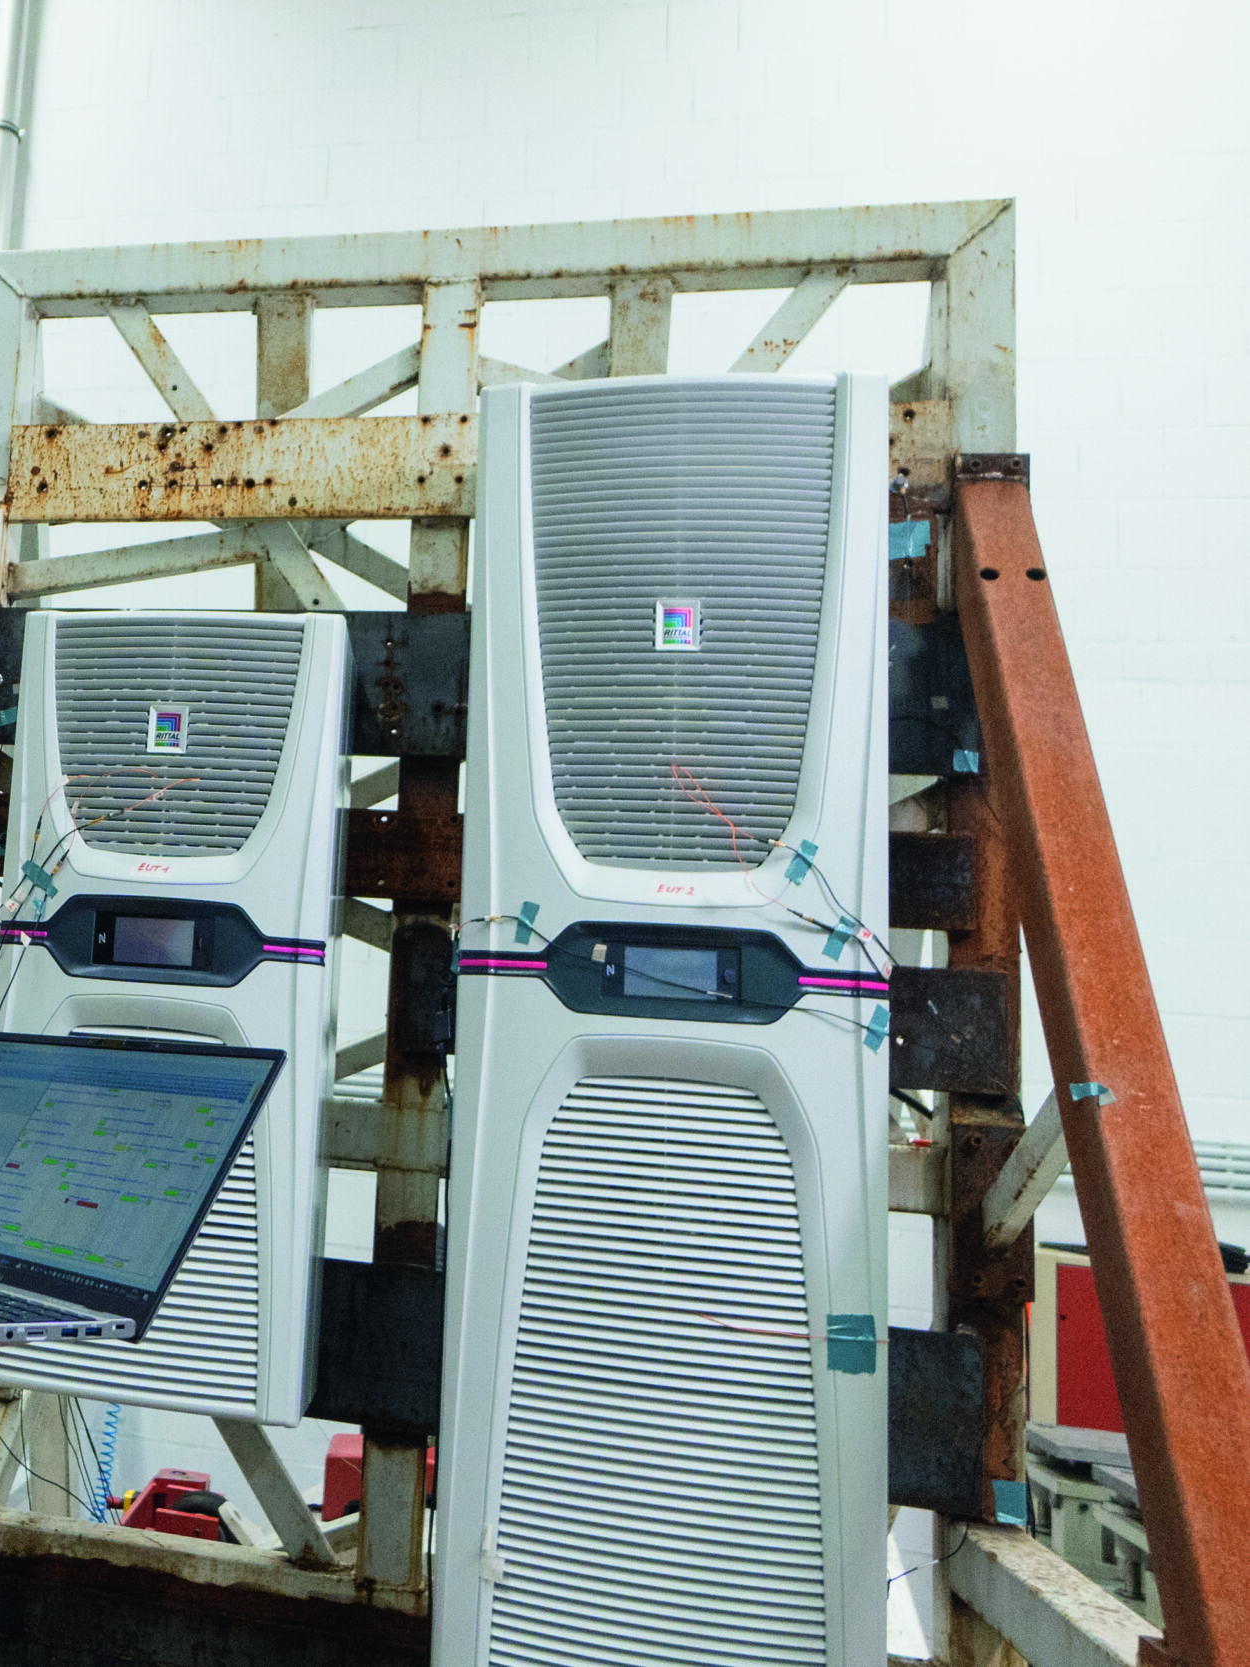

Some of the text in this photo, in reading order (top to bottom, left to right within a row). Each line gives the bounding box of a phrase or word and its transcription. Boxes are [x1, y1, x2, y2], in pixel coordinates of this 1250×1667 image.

[664, 629, 691, 637] RITTAL
[156, 732, 181, 740] RITTAL
[685, 886, 695, 896] 2
